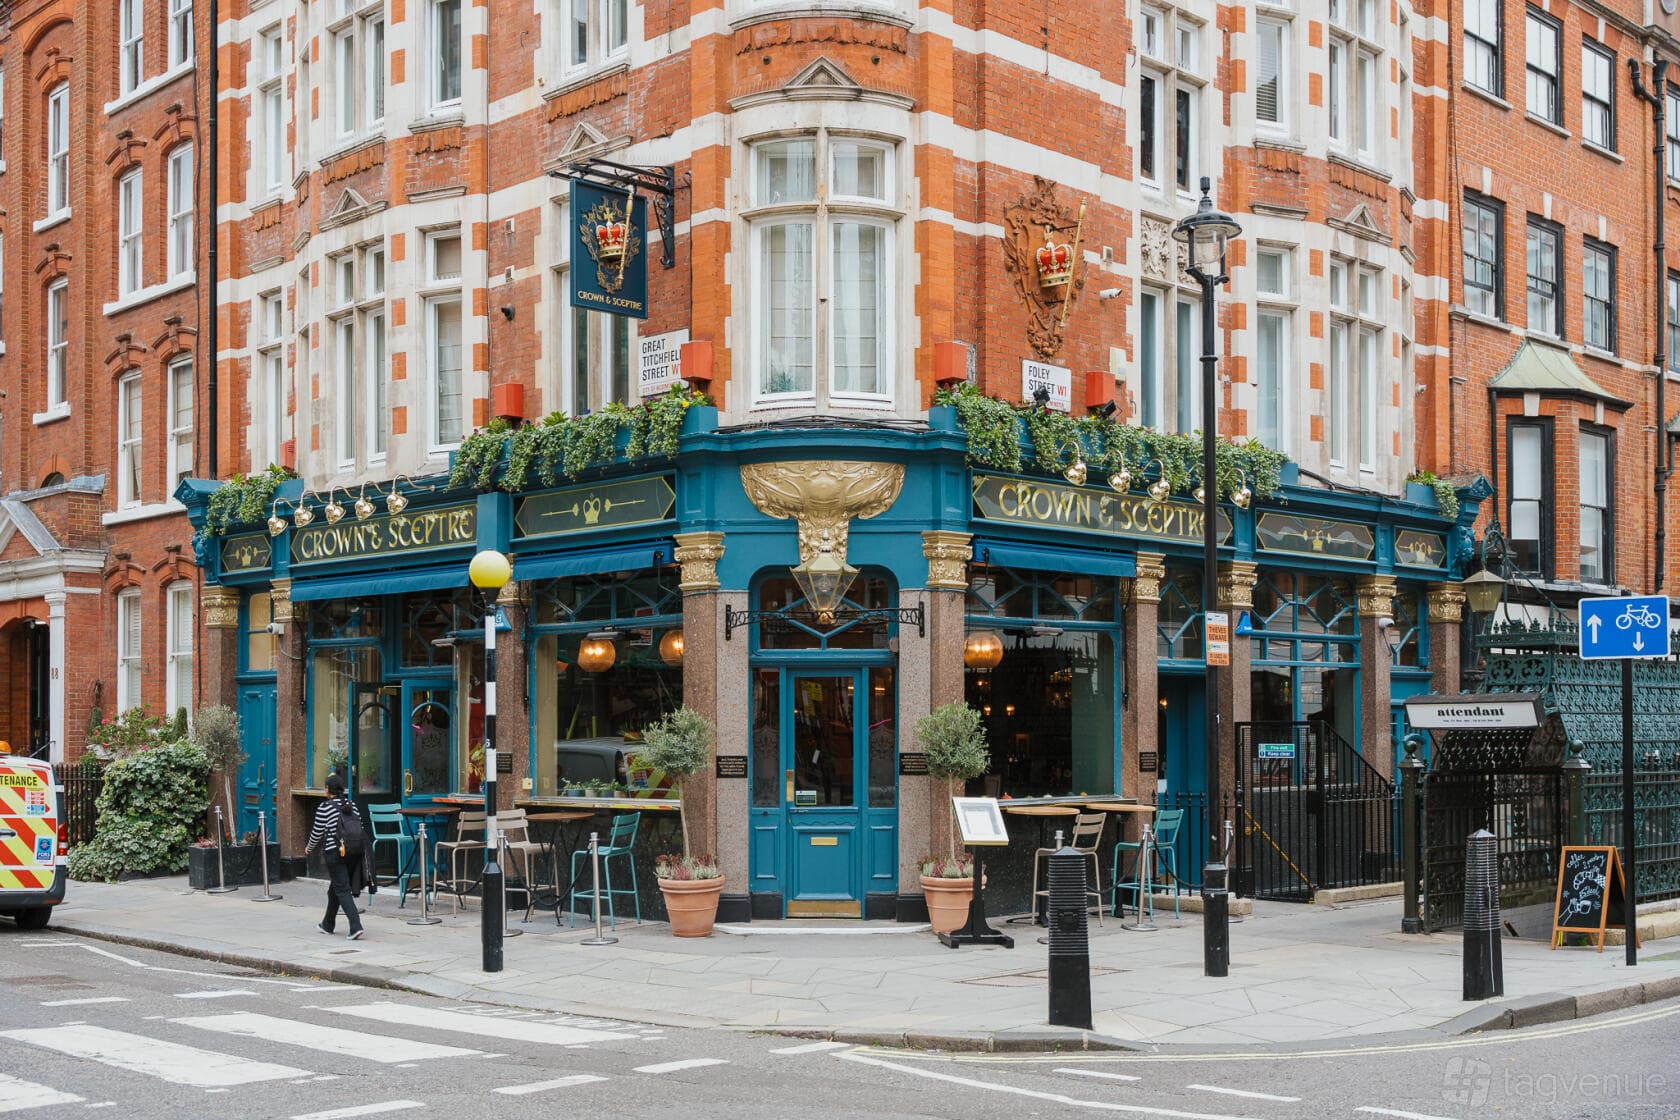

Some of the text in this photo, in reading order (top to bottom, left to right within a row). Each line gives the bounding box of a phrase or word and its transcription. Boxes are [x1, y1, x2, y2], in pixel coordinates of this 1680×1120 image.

[578, 290, 643, 310] CROWN & SCEPTRE
[642, 338, 666, 354] GREAT
[642, 349, 681, 367] TITCHFIEL
[642, 366, 670, 381] STREET
[1028, 366, 1050, 380] FOLEY
[1057, 385, 1067, 397] W1
[998, 483, 1092, 525] CROWN
[301, 509, 474, 559] CROWN & SCEPTRE
[1437, 706, 1505, 717] attendant
[0, 775, 38, 786] TENANCE
